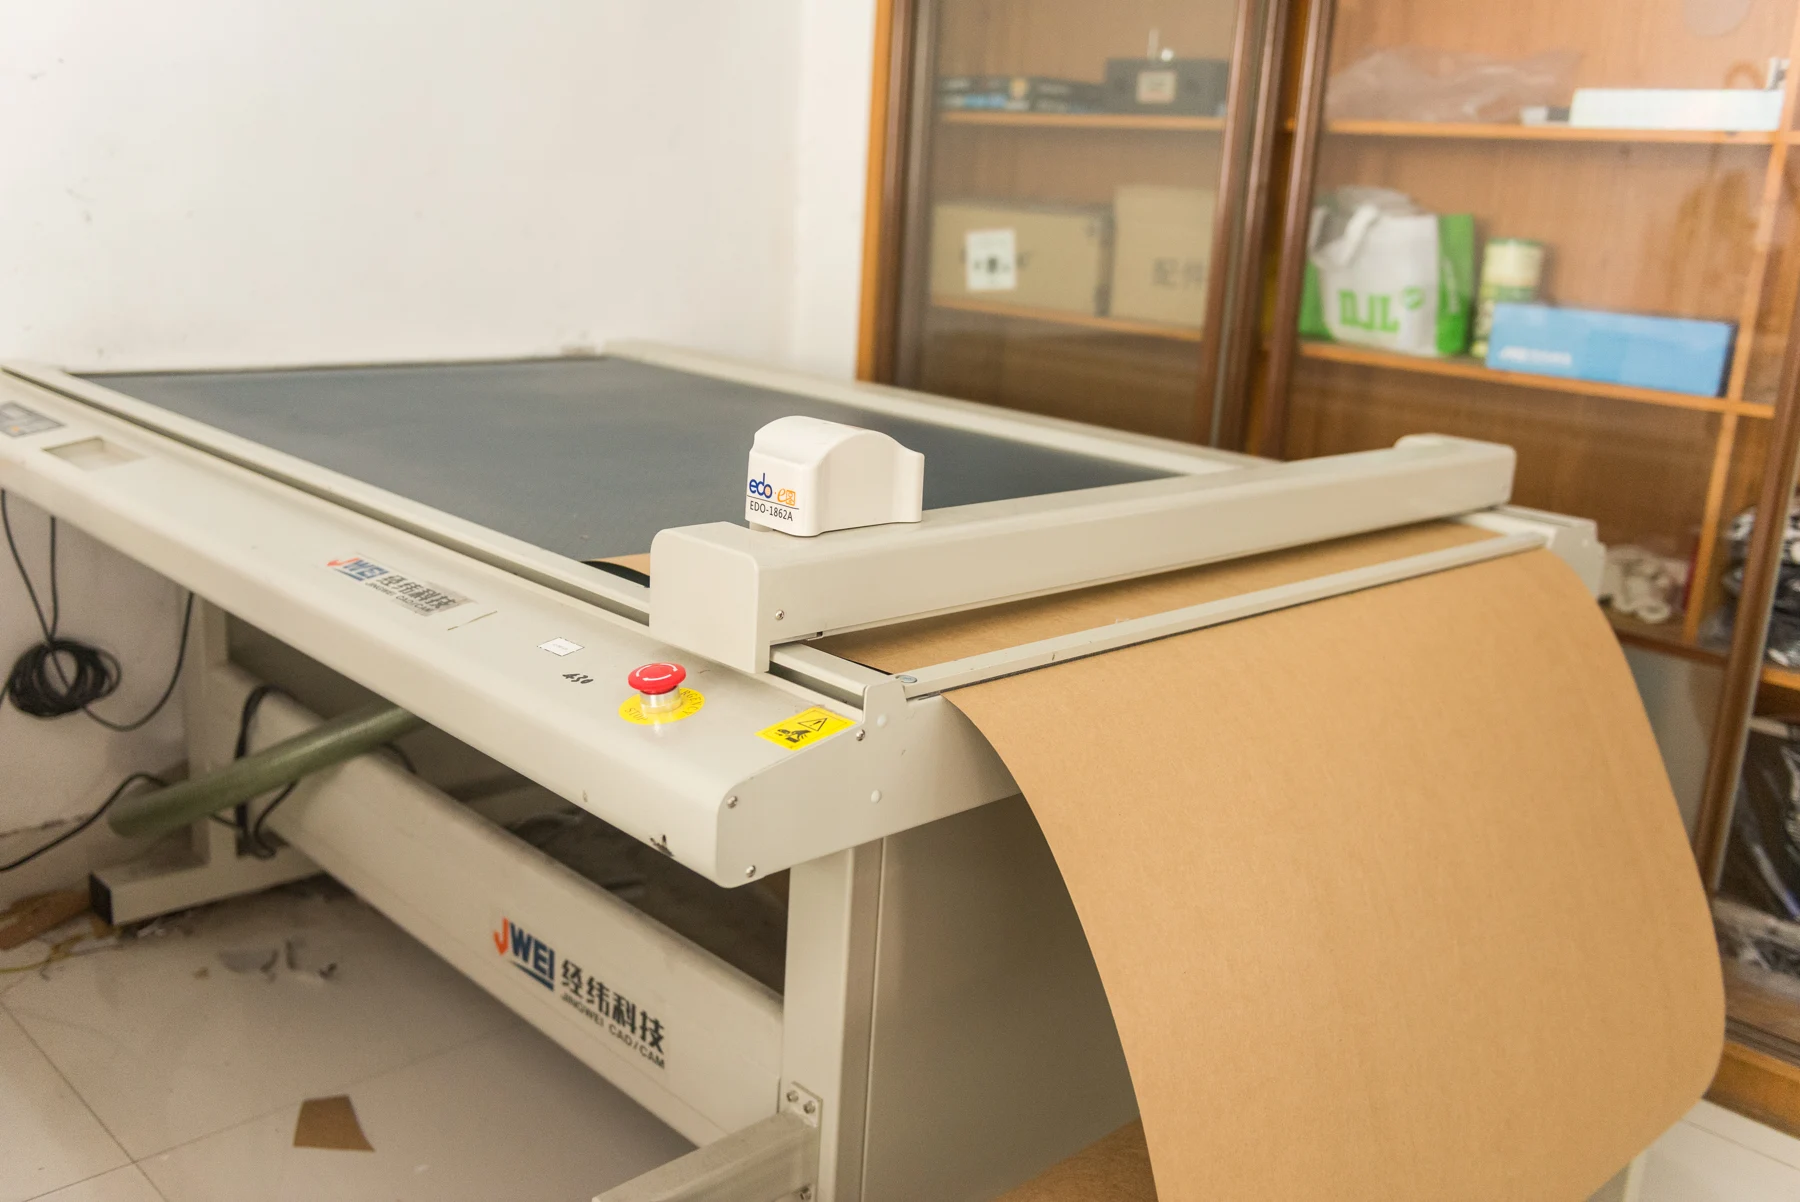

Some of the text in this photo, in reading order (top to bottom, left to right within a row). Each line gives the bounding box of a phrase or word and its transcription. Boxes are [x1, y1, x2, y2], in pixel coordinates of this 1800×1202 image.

[749, 472, 773, 499] edo
[750, 500, 793, 522] EDO-1862A
[326, 557, 389, 580] JWEI
[376, 574, 457, 610] 经纬科技
[624, 707, 649, 721] STOP
[493, 917, 556, 981] JWEI
[561, 959, 665, 1054] 经纬科技
[560, 991, 666, 1070] JINGWEI CAD/CAM
